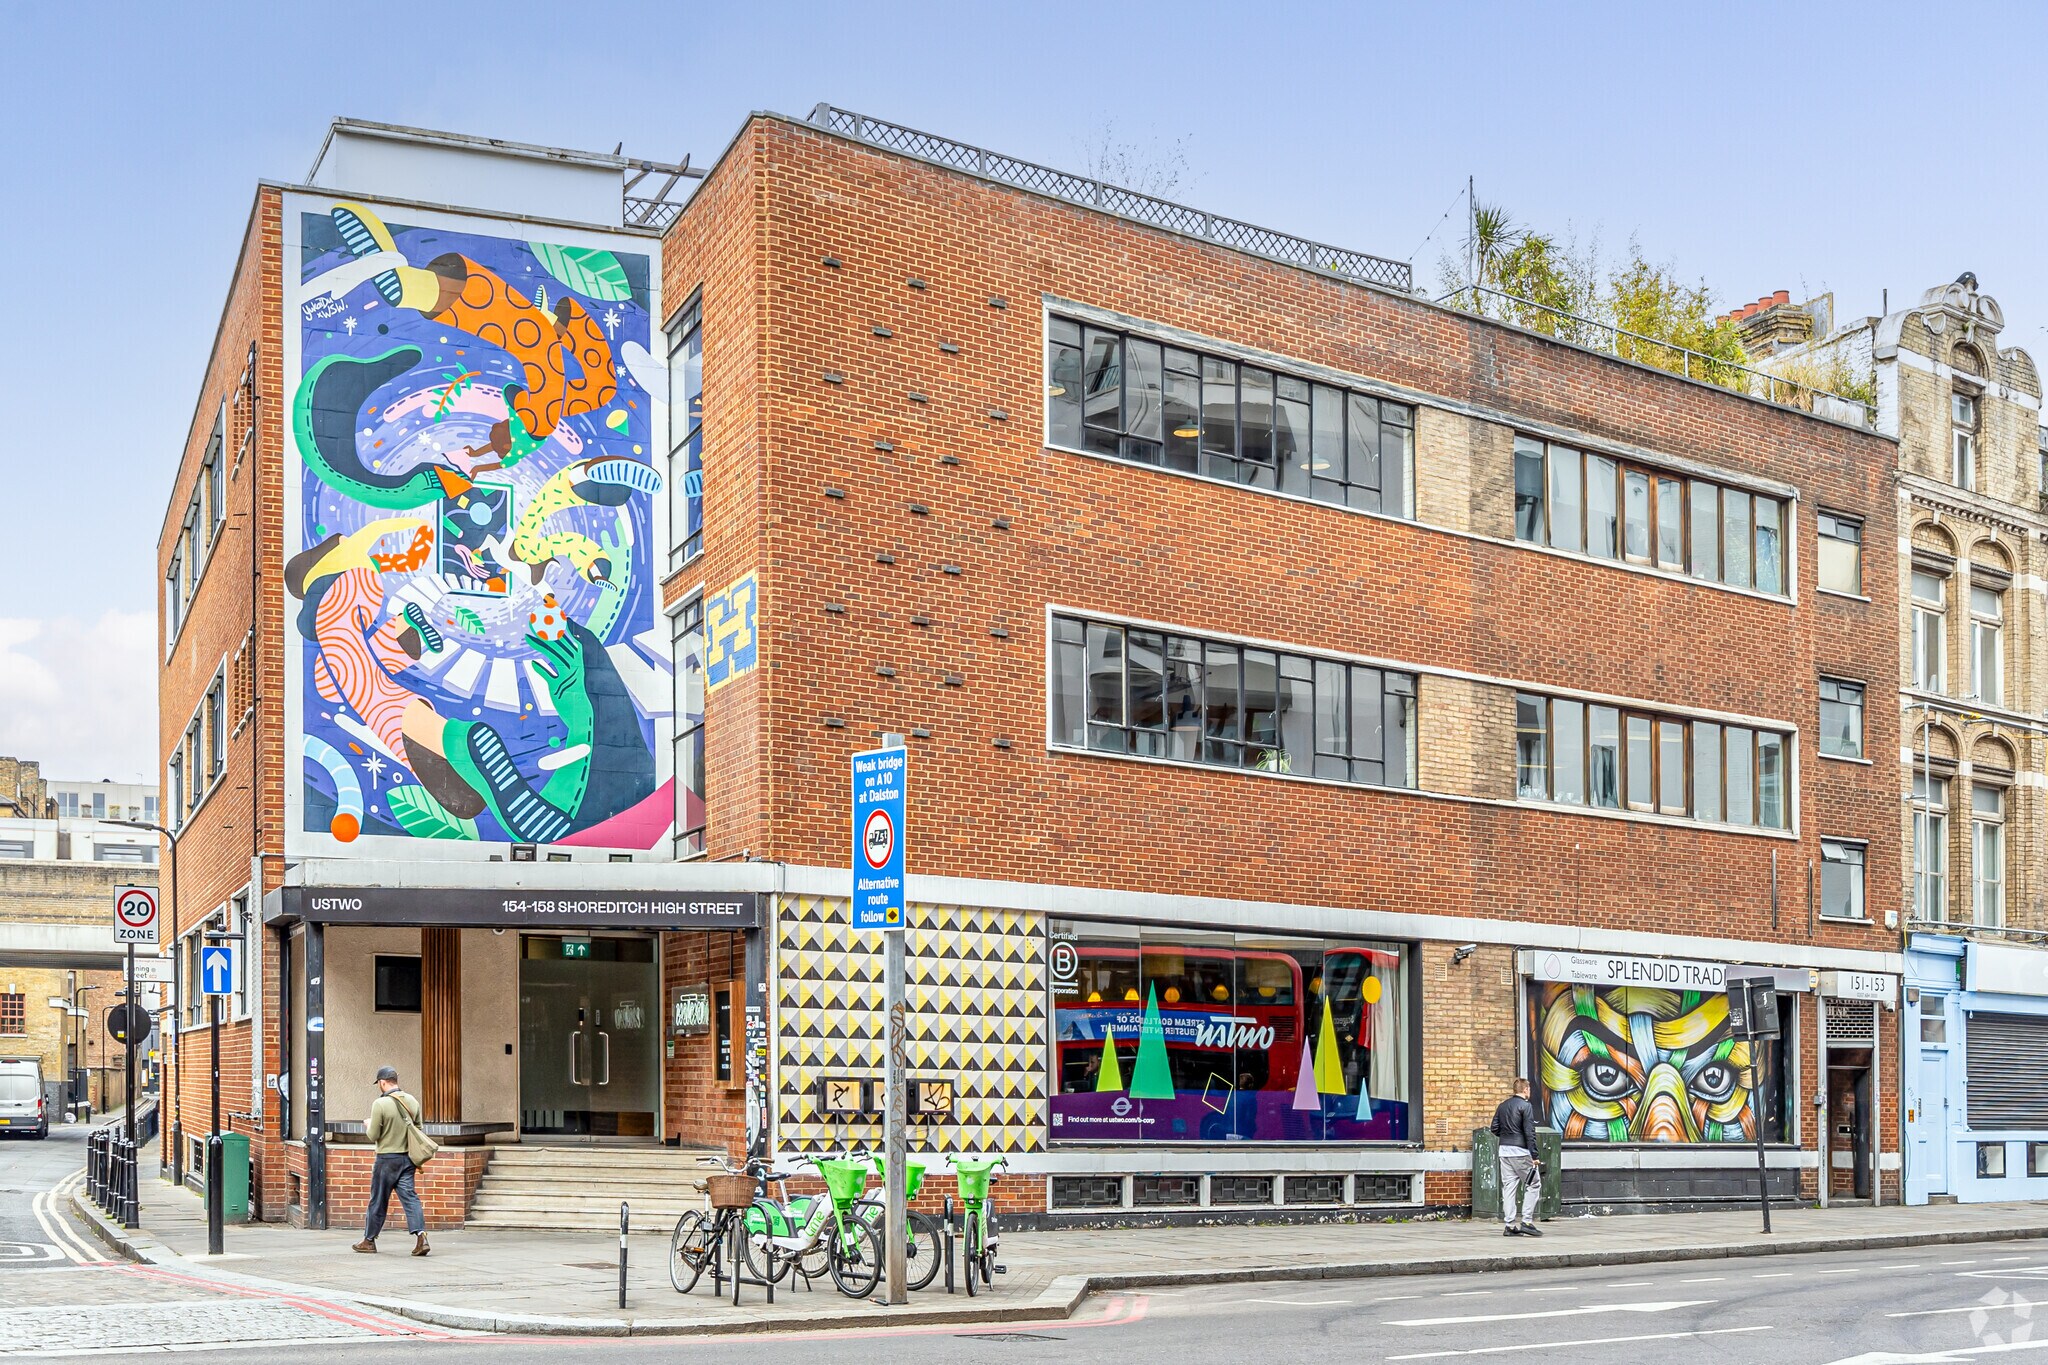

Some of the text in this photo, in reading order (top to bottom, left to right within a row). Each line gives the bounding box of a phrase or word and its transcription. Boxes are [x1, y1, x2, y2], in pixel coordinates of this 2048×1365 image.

[856, 756, 903, 773] Weak bridge
[865, 771, 893, 788] on A10
[859, 788, 899, 804] at Dalston
[857, 877, 899, 891] Alternative
[311, 898, 362, 910] USTWO
[867, 893, 889, 906] route
[123, 900, 150, 917] 20
[502, 900, 744, 915] 154-158 SHOREDITCH HIGH STREET
[860, 910, 885, 924] follow
[119, 929, 154, 940] ZONE
[1049, 931, 1078, 941] Certified
[1056, 948, 1071, 972] B
[1570, 956, 1598, 966] Glassware
[1570, 970, 1598, 980] Tableware
[1607, 960, 1727, 986] SPLENDID TRADI
[1850, 975, 1886, 992] 151-153
